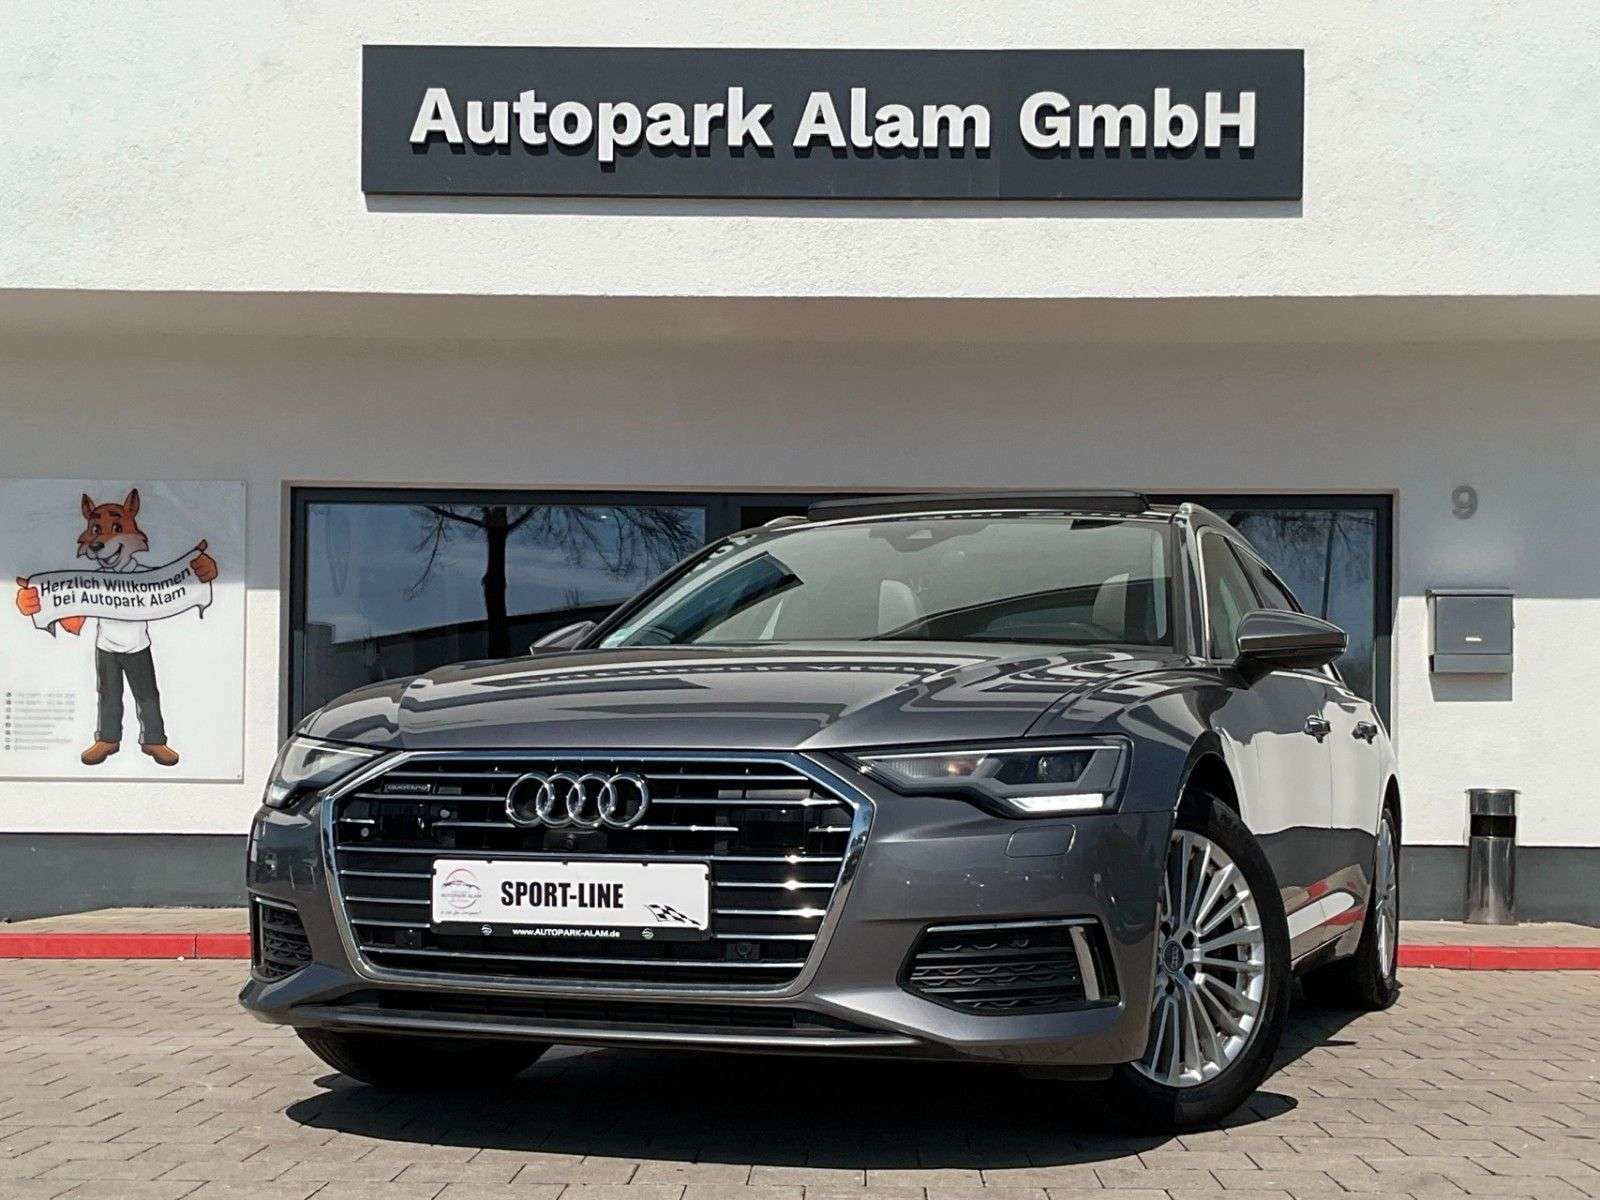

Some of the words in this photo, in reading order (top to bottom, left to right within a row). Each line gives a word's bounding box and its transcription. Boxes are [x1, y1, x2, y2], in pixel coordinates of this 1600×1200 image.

[410, 86, 773, 163] Autopark
[794, 88, 991, 150] Alam
[1019, 88, 1256, 150] GmbH
[1451, 484, 1478, 520] 9
[40, 577, 100, 597] Herzlich
[103, 567, 191, 593] Willkommen
[53, 592, 76, 608] bei
[80, 591, 145, 609] Autopark
[150, 586, 187, 607] Alam
[501, 881, 624, 908] SPORT-LINE
[512, 928, 620, 938] www.AUTOPARK-ALAM.de
